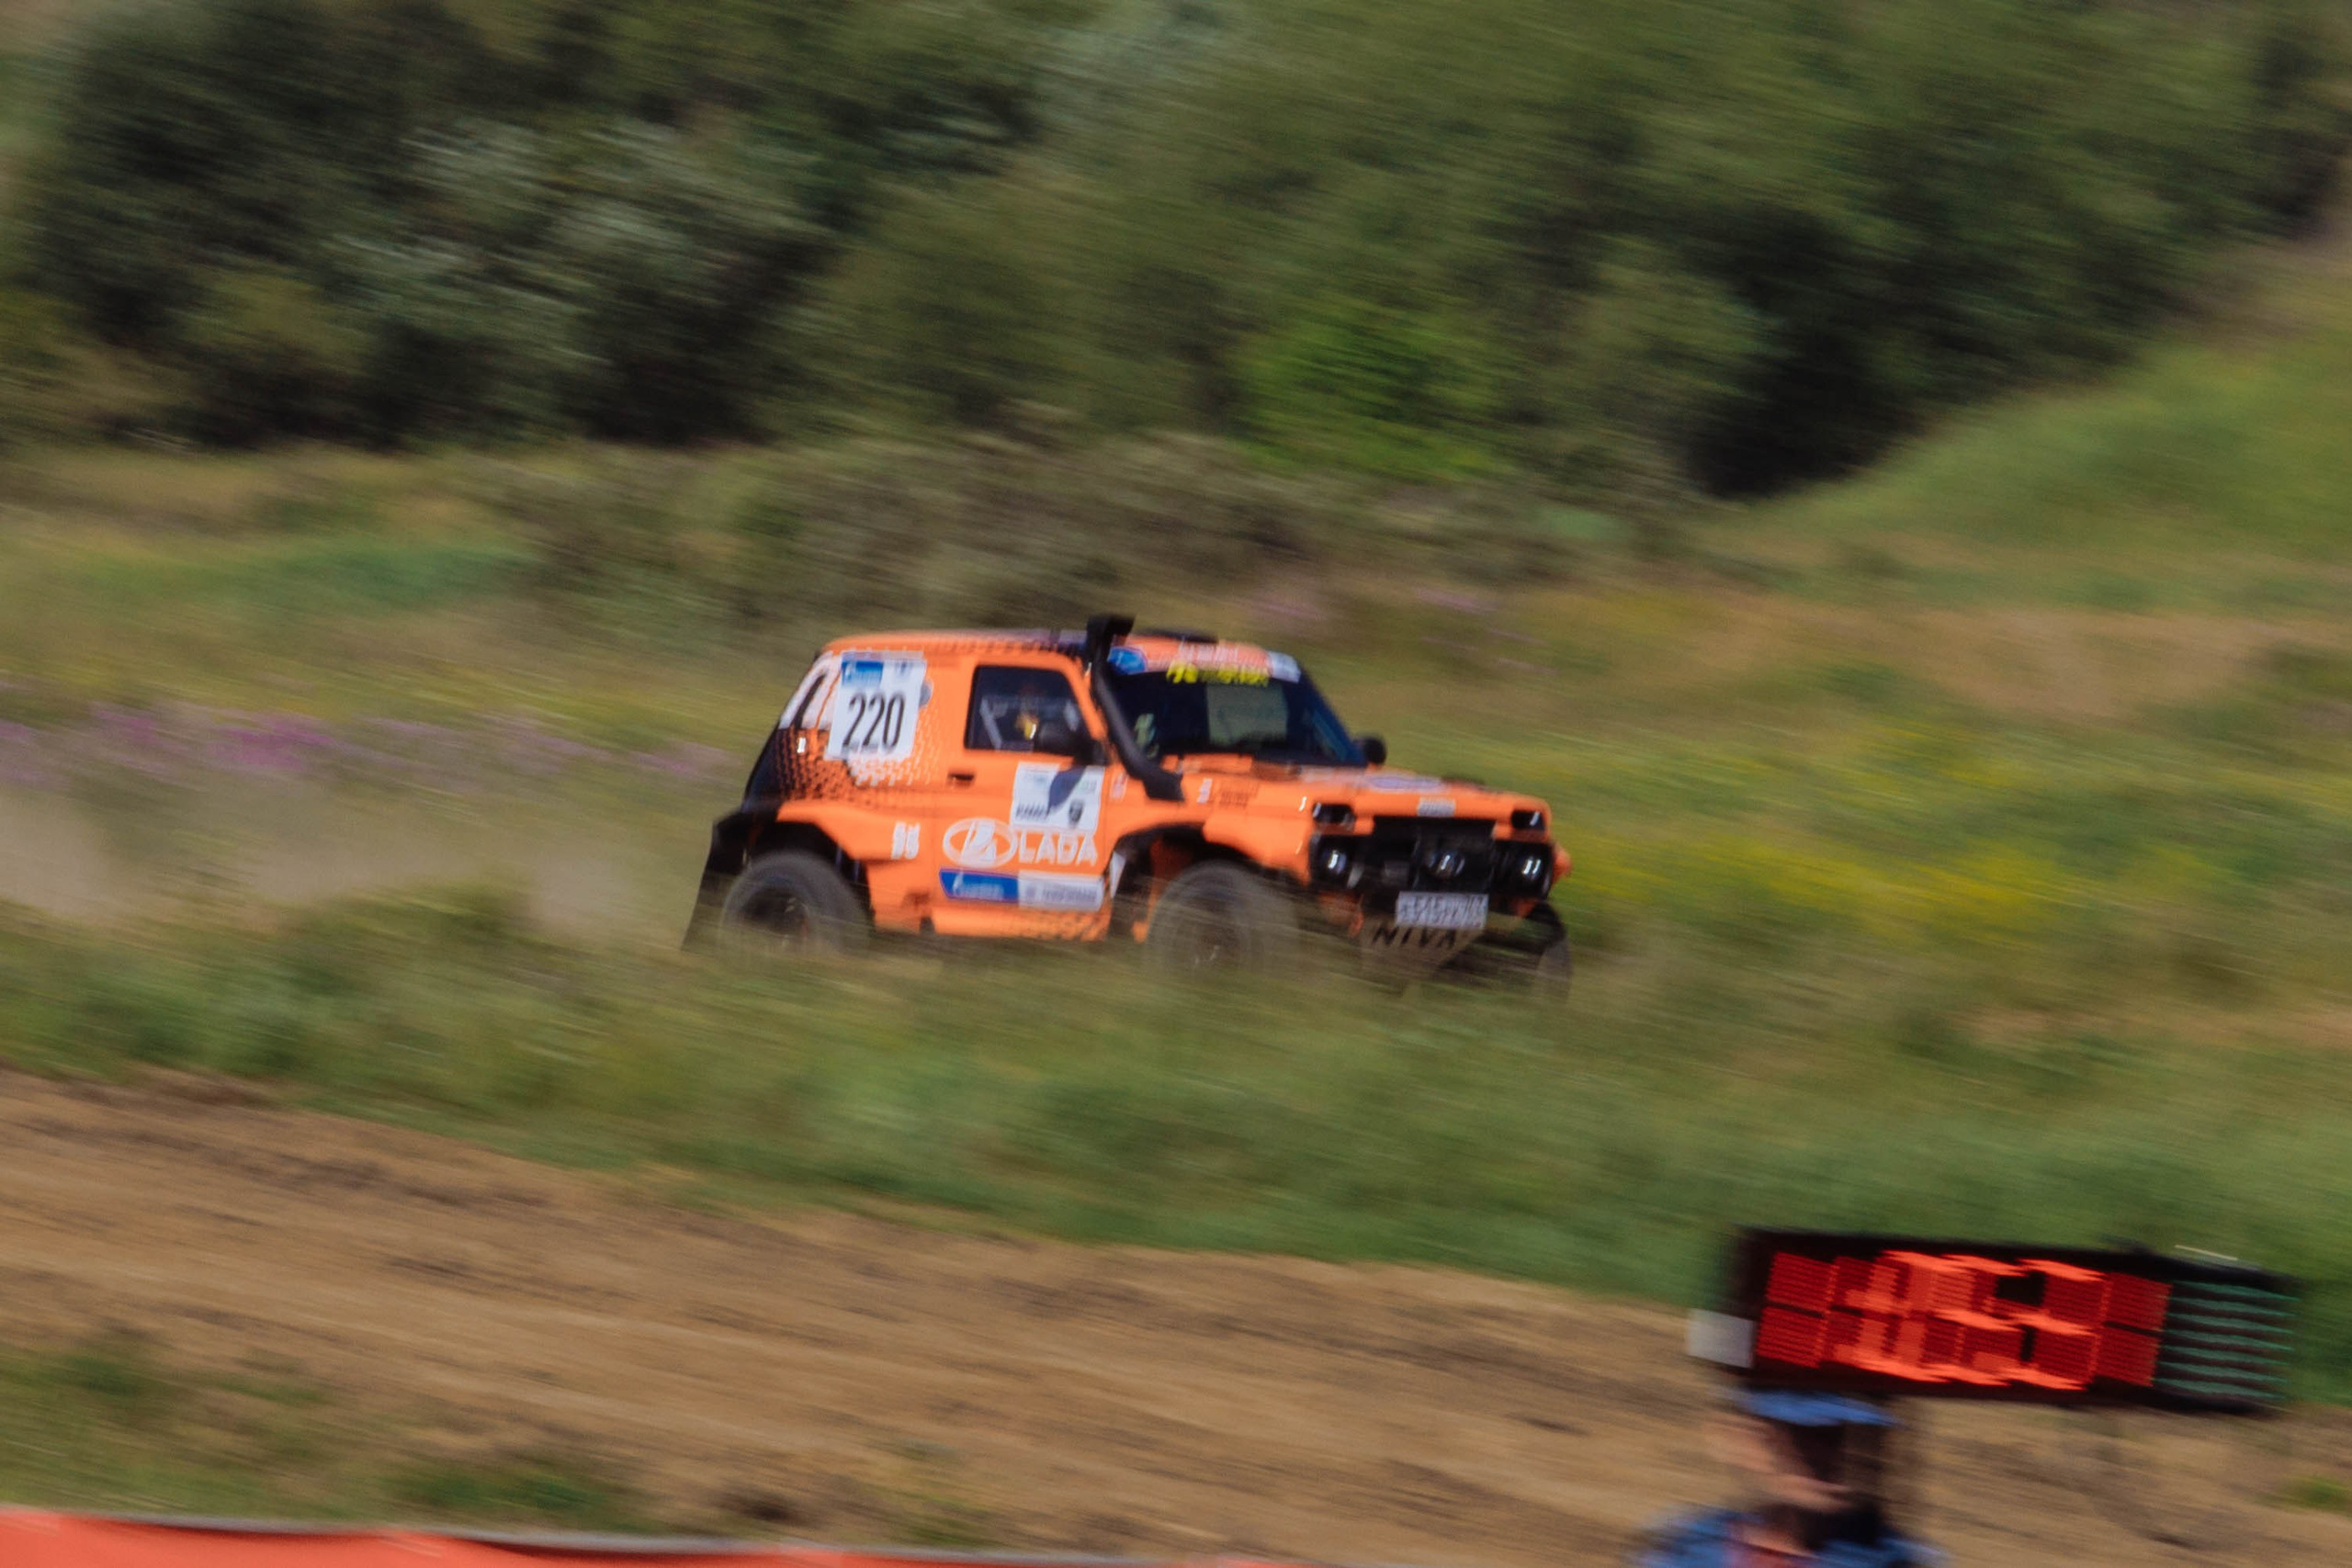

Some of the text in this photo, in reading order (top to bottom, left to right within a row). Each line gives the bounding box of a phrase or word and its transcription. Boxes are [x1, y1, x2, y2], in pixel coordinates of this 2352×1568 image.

[841, 692, 906, 752] 220
[1019, 828, 1099, 866] LADA
[1372, 923, 1457, 947] NIVA
